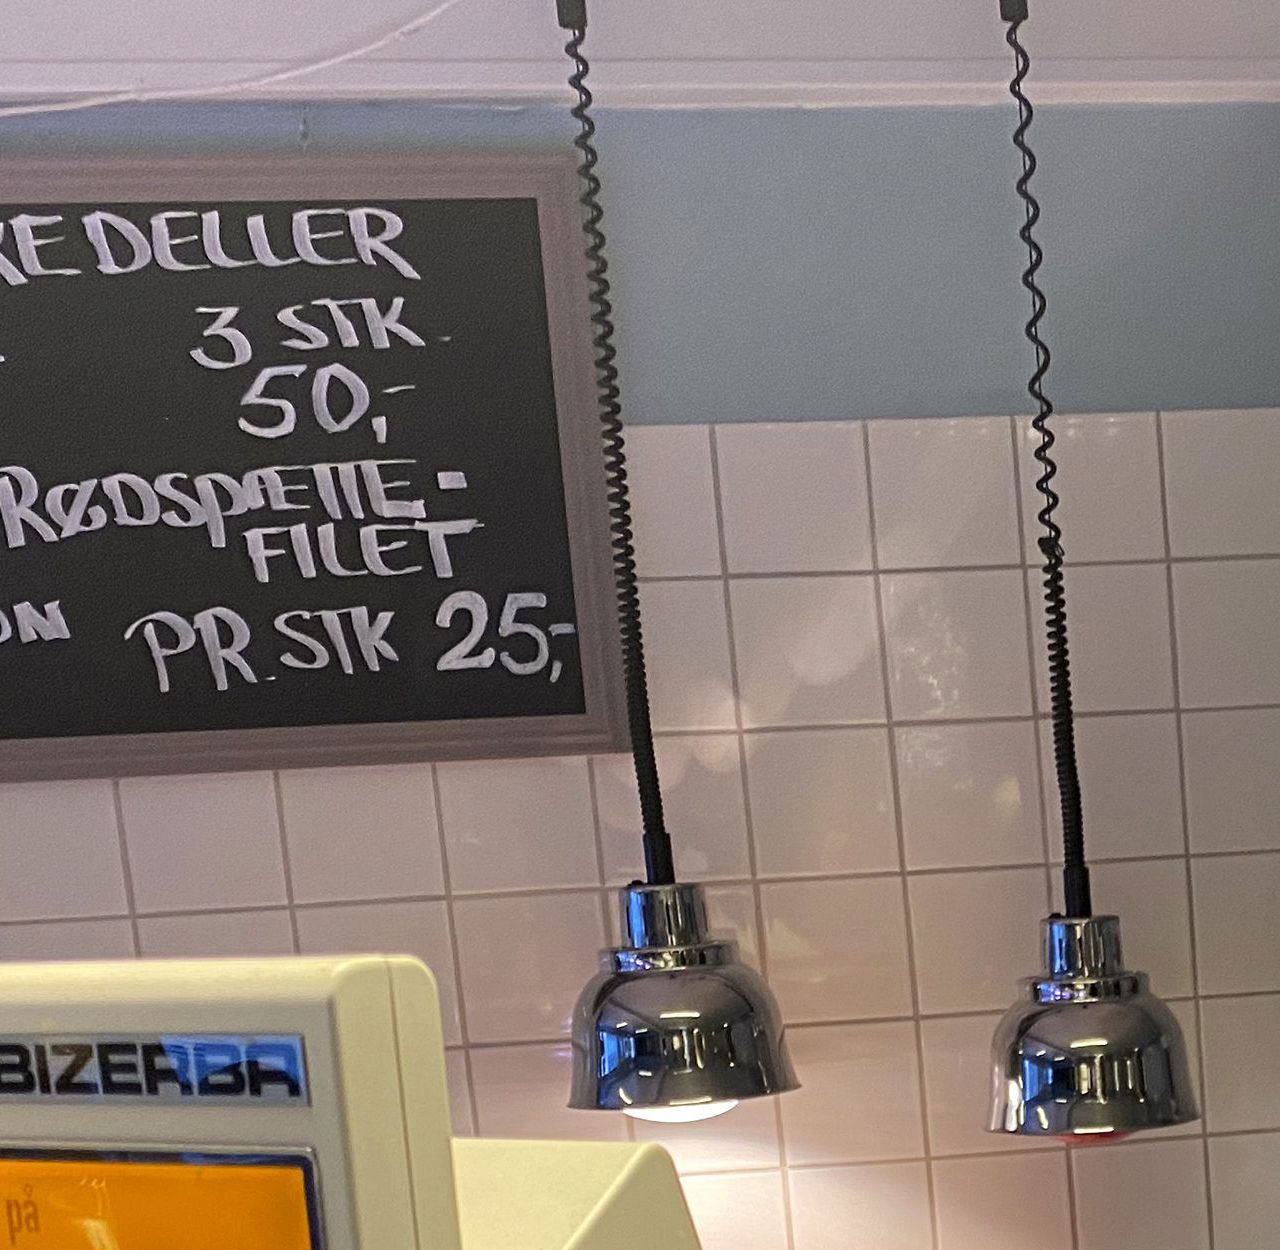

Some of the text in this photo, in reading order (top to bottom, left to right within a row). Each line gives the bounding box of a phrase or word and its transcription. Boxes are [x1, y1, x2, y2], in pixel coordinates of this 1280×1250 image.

[190, 307, 252, 369] 3
[238, 363, 416, 443] 50,-
[243, 519, 485, 583] FILET
[273, 606, 399, 675] STK
[436, 590, 575, 682] 25,-
[0, 1044, 301, 1097] BIZERBA
[5, 1182, 41, 1248] på
